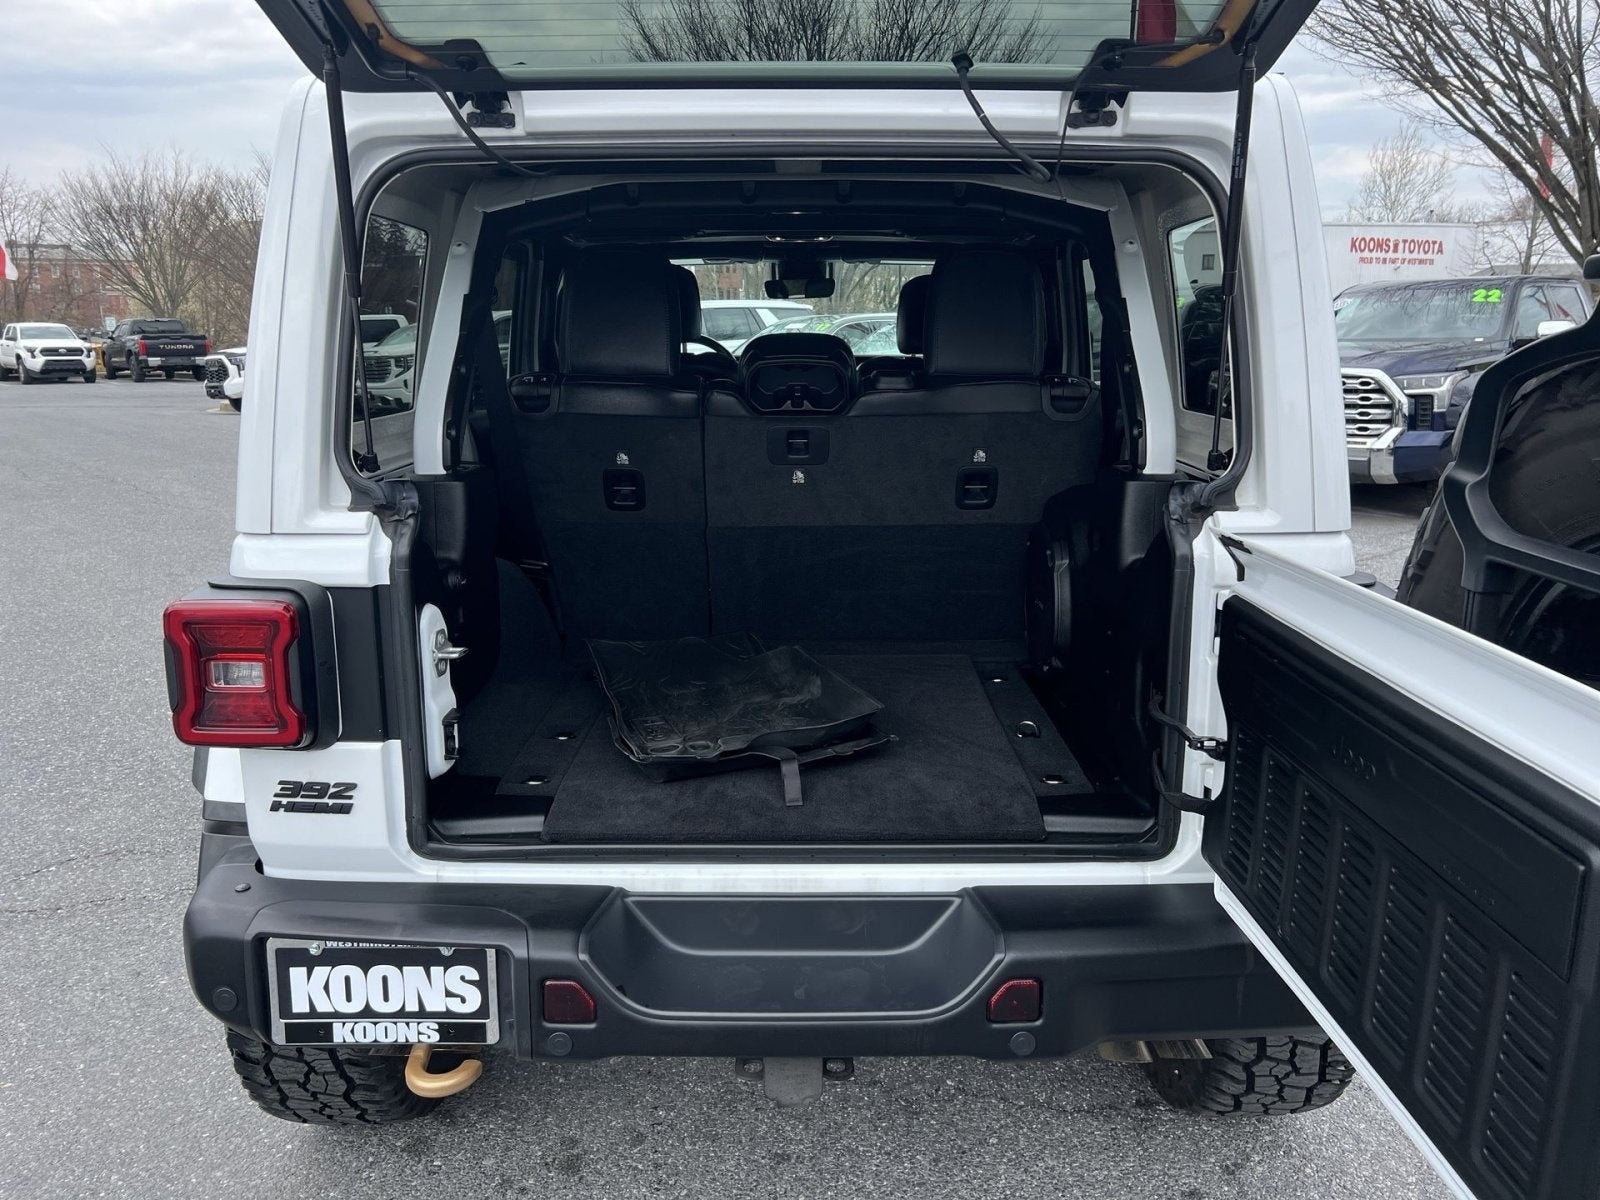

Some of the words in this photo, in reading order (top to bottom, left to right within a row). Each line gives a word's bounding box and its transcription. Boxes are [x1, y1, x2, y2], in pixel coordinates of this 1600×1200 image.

[1350, 237, 1391, 253] KOONS
[1401, 239, 1444, 255] TOYOTA
[1359, 257, 1374, 265] PROUD
[1374, 257, 1381, 265] TO
[1382, 257, 1388, 265] BE
[1472, 289, 1502, 302] 22
[273, 780, 358, 800] 392
[269, 800, 354, 815] HEMI
[289, 964, 482, 1014] KOONS
[332, 1021, 440, 1043] KOONS
